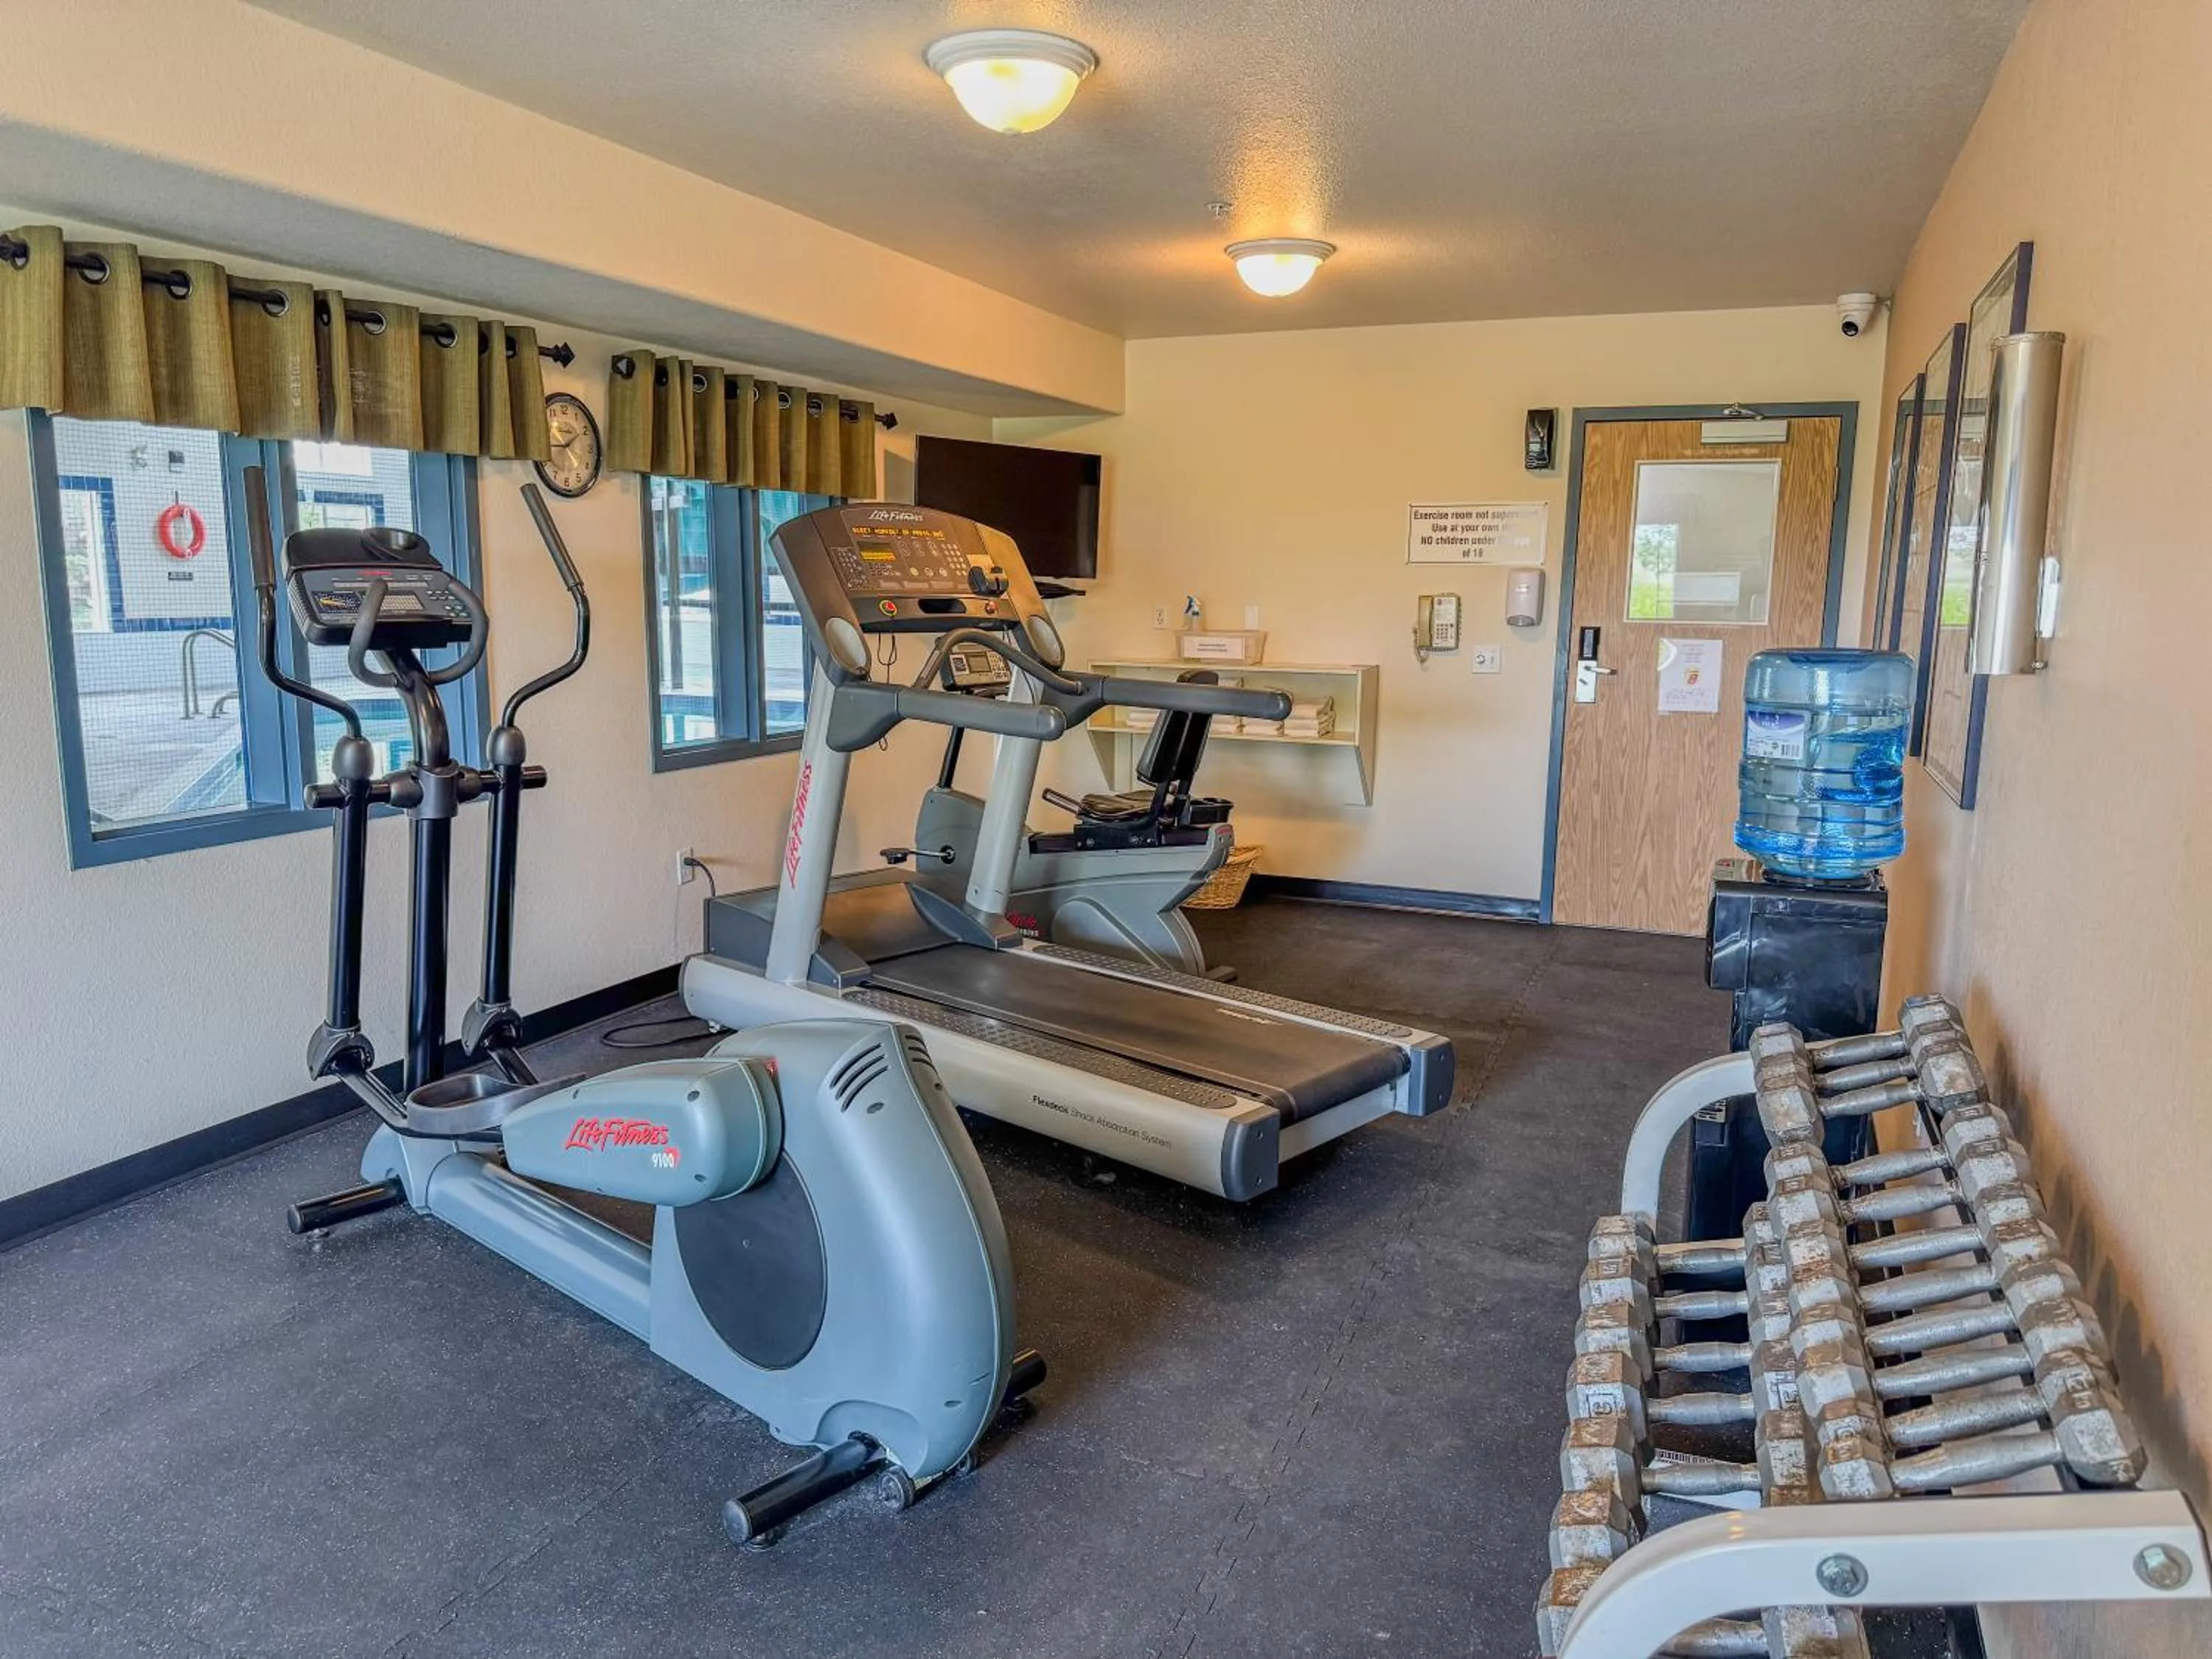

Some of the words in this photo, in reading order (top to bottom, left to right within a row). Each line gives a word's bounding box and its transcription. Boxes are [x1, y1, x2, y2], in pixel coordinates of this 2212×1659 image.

[1413, 510, 1449, 520] Exercise
[1451, 510, 1473, 520] room
[1476, 510, 1489, 519] not
[1432, 523, 1447, 532] Use
[1461, 524, 1479, 534] your
[1481, 524, 1498, 532] own
[1421, 535, 1433, 545] NO
[1436, 535, 1470, 545] children
[1472, 535, 1495, 545] under
[1463, 548, 1470, 557] of
